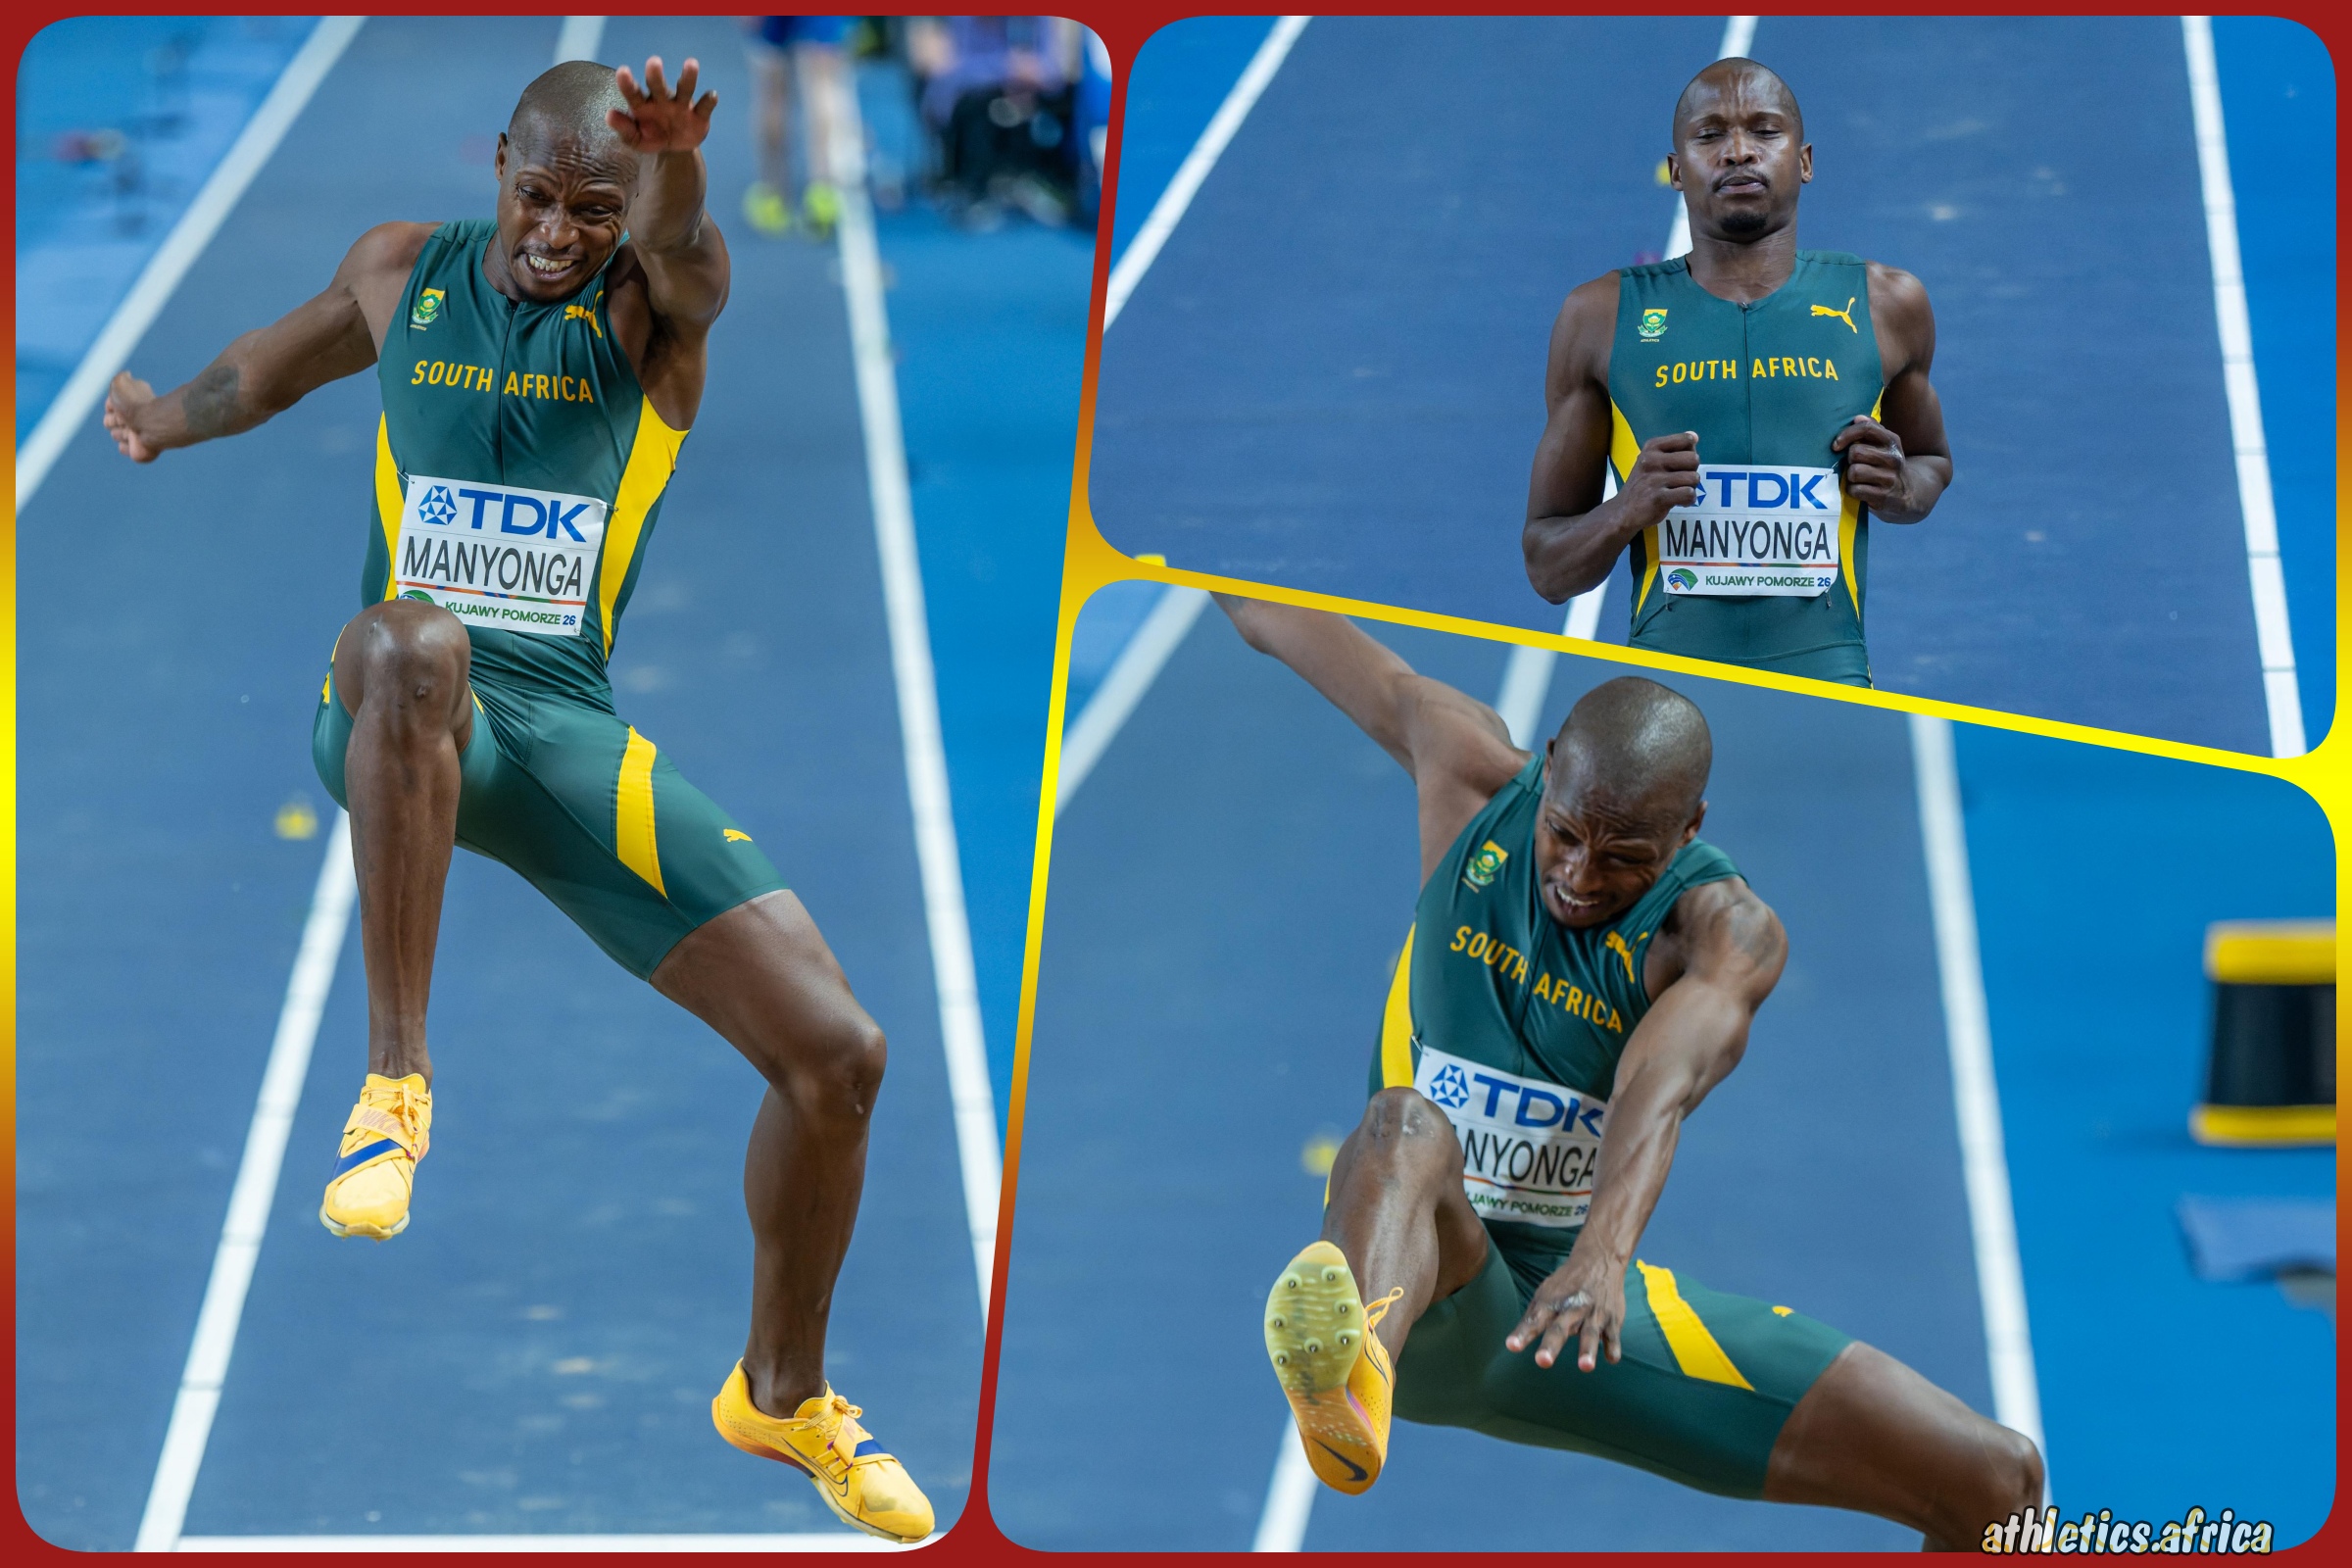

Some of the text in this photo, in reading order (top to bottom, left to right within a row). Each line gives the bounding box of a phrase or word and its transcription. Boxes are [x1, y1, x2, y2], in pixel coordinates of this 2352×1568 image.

[411, 360, 594, 404] SOUTH AFRICA
[1655, 357, 1839, 388] SOUTH AFRICA
[1705, 471, 1828, 510] TDK
[459, 488, 591, 543] TDK
[1666, 519, 1832, 561] MANYONGA
[403, 536, 582, 597] MANYONGA
[1705, 575, 1831, 587] KUJAWY POMORZE 26
[445, 601, 576, 626] KUJAWY POMORZE 26
[1449, 925, 1623, 1034] SOUTH AFRICA
[1474, 1072, 1604, 1139] TDK
[1455, 1126, 1596, 1188] NYONGA
[1510, 1201, 1572, 1217] POMORZE
